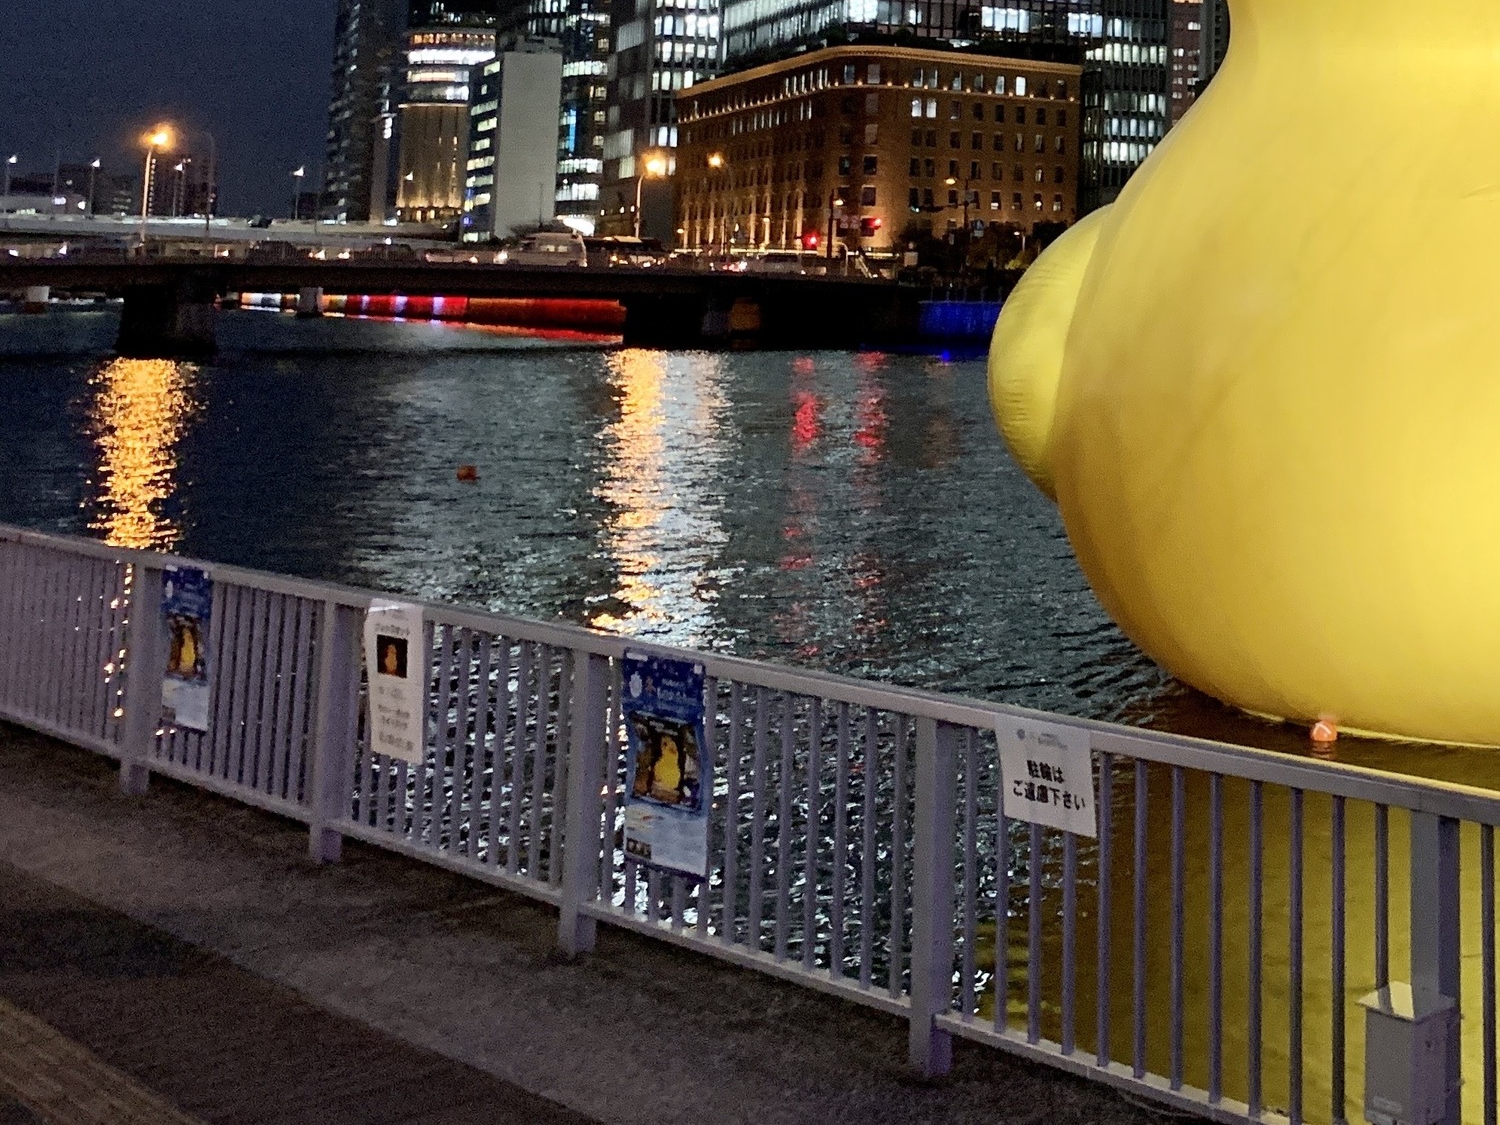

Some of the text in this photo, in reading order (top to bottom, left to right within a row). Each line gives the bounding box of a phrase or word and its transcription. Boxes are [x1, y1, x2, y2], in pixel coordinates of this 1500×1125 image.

[1027, 760, 1064, 783] 駐輪は
[1013, 780, 1086, 810] ご遠慮下さい
